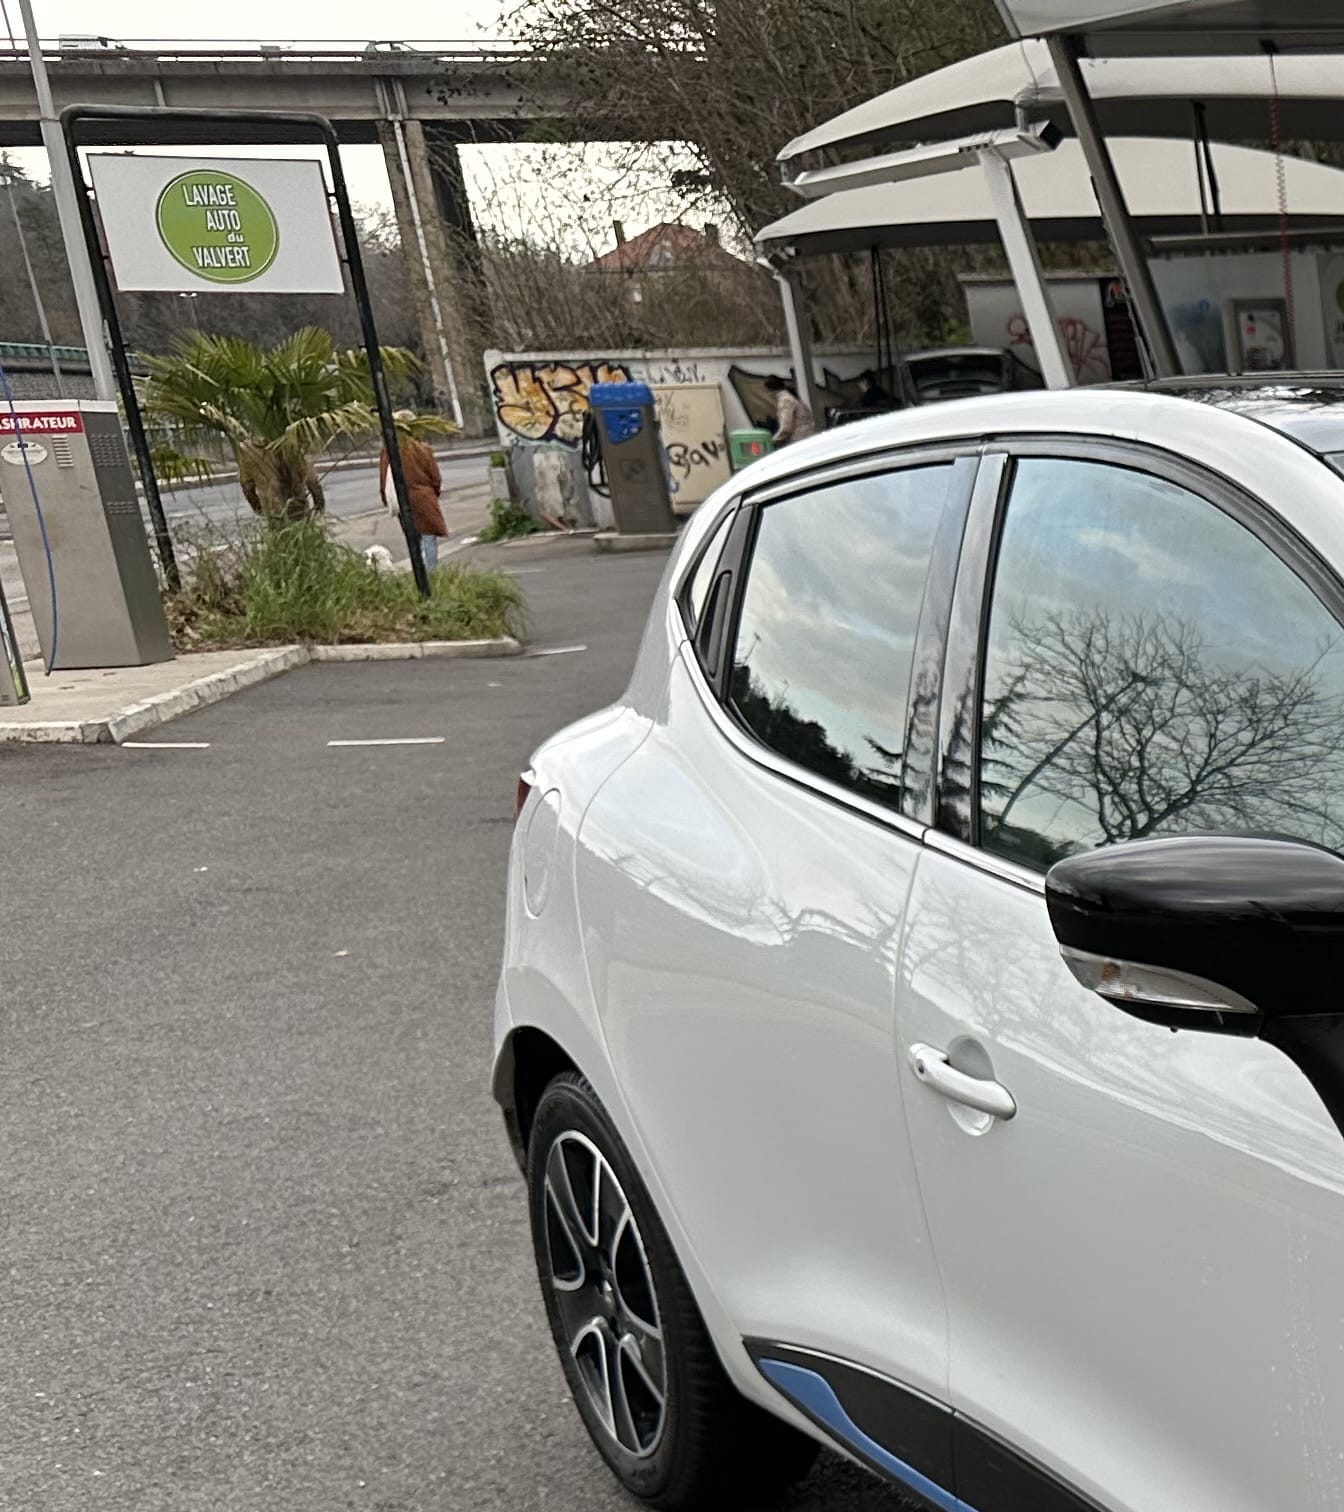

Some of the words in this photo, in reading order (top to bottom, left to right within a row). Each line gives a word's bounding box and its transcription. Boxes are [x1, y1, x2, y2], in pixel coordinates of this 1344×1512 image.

[183, 184, 237, 206] LAVAGE
[206, 210, 241, 231] AUTO
[227, 232, 244, 242] du
[192, 246, 251, 267] VALVERT
[0, 417, 77, 430] SPIRATEUR
